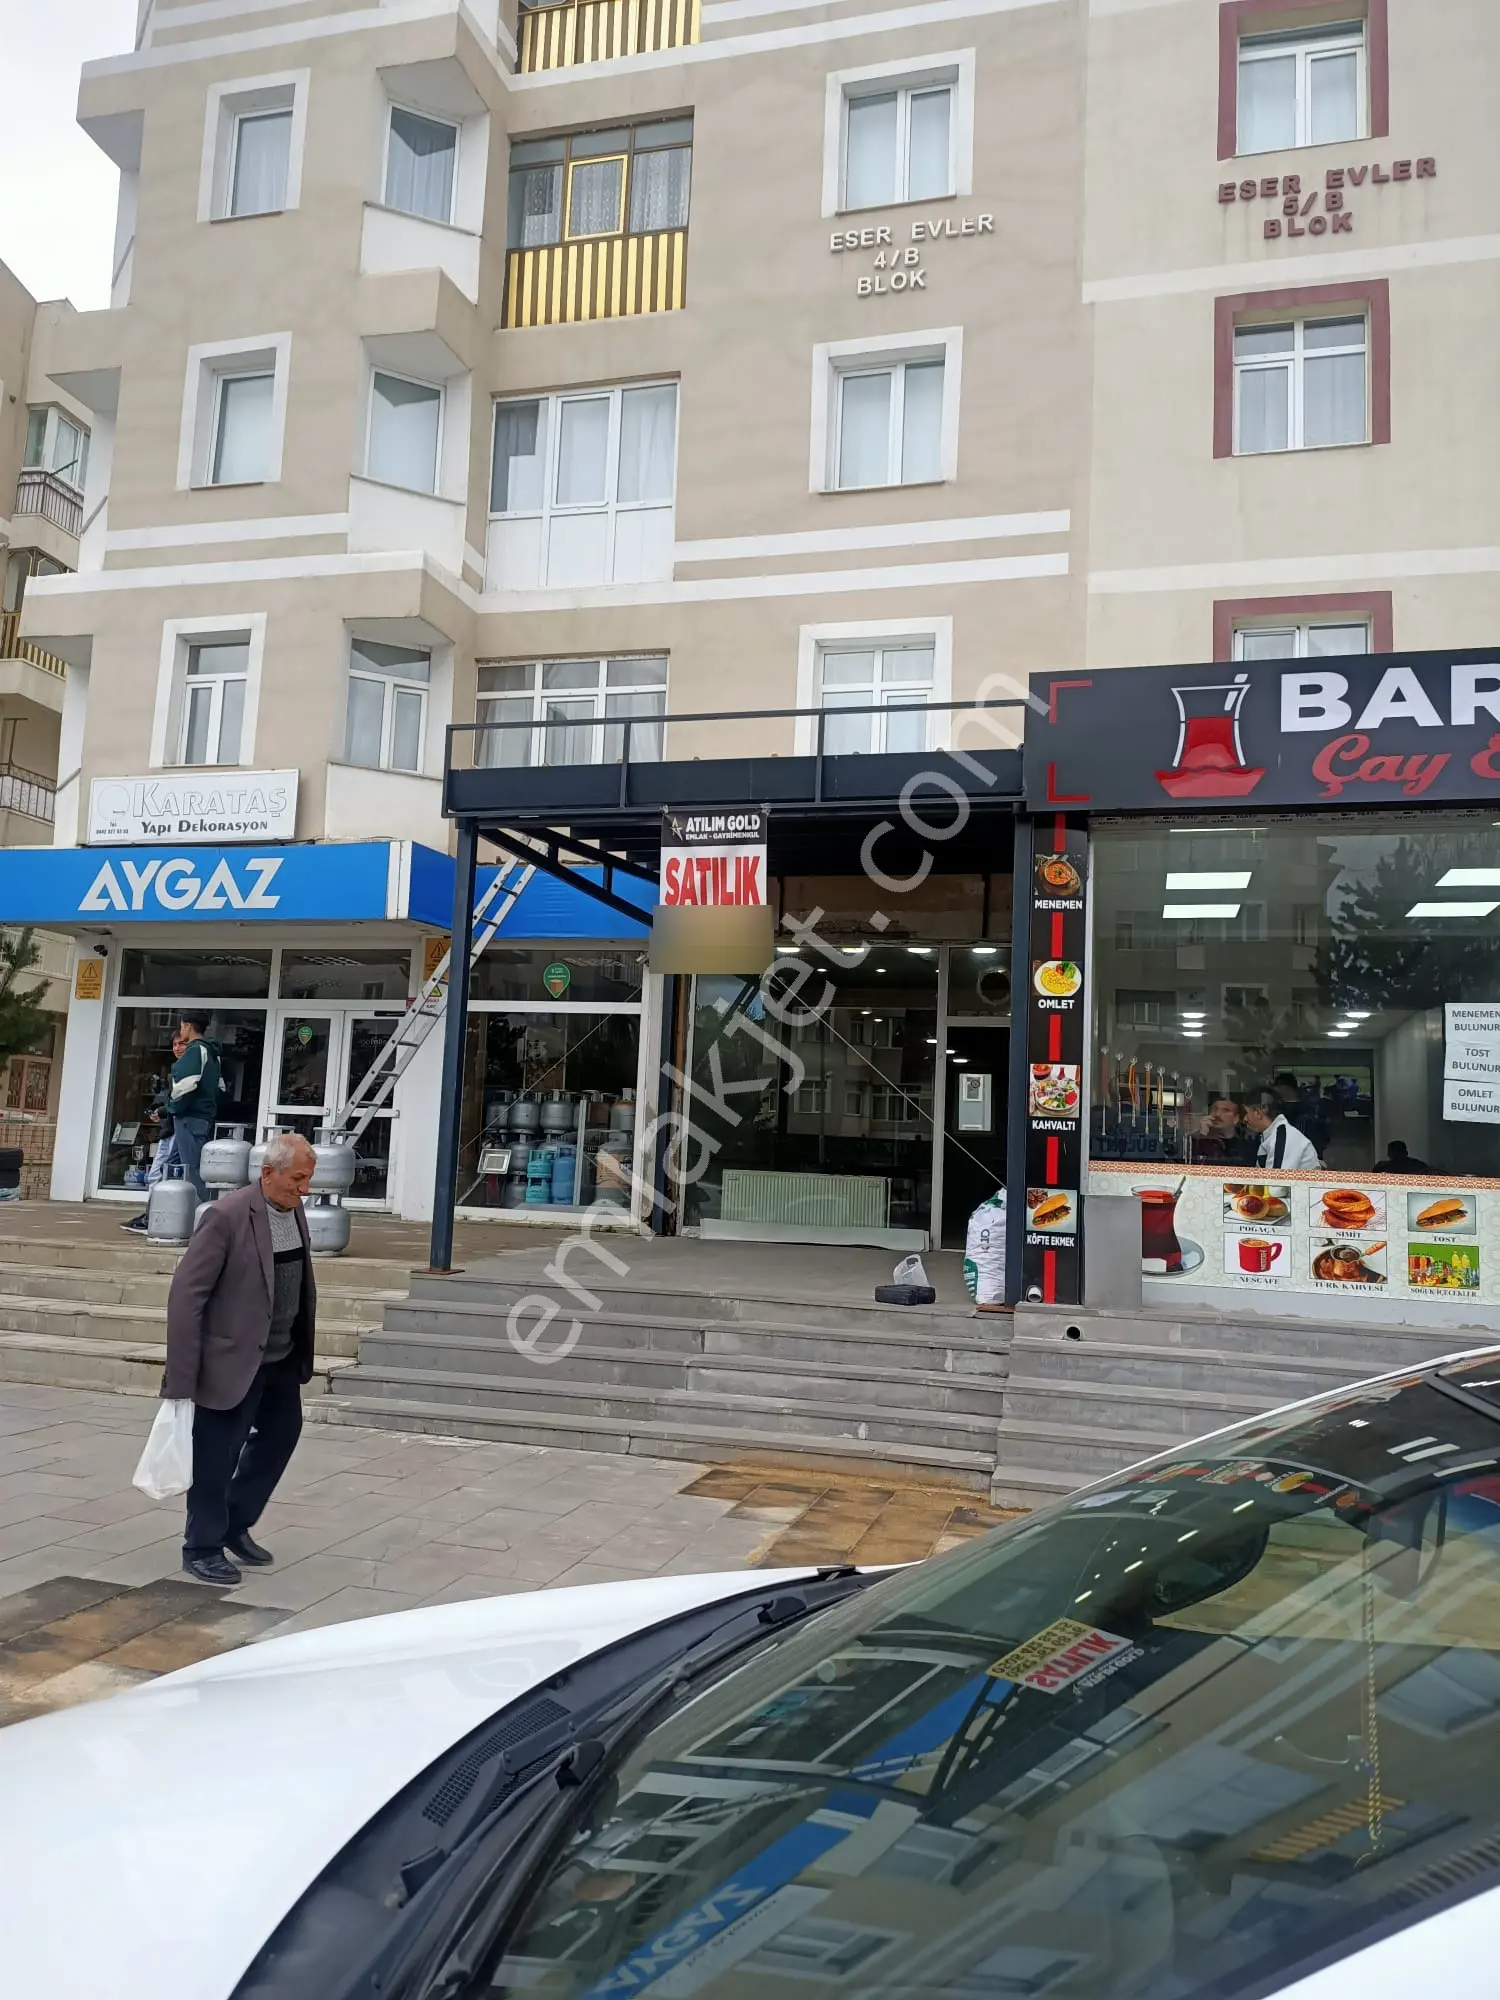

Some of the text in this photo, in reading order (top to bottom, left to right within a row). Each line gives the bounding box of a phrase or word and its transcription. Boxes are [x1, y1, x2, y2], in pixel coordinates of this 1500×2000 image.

[1218, 157, 1437, 203] ESER EVLER
[1283, 191, 1344, 216] 5/B
[830, 213, 993, 252] ESER EVLER
[1263, 211, 1353, 239] BLOK
[873, 247, 919, 269] 4/B
[857, 269, 927, 297] BLOK
[1312, 732, 1451, 798] Çay
[132, 782, 288, 818] KARATAŞ
[685, 815, 761, 832] ATILIM GOLD
[77, 857, 285, 911] AYGAZ
[664, 856, 761, 906] SATILIK
[1034, 899, 1083, 910] MENEMEN
[1038, 999, 1075, 1009] OMLET
[1465, 1048, 1490, 1058] TOST
[1458, 1088, 1493, 1099] OMLET
[1451, 1102, 1500, 1113] BULUNUR
[1032, 1119, 1076, 1131] KAHVALTI
[1027, 1233, 1075, 1247] KÖFTE EKMEK
